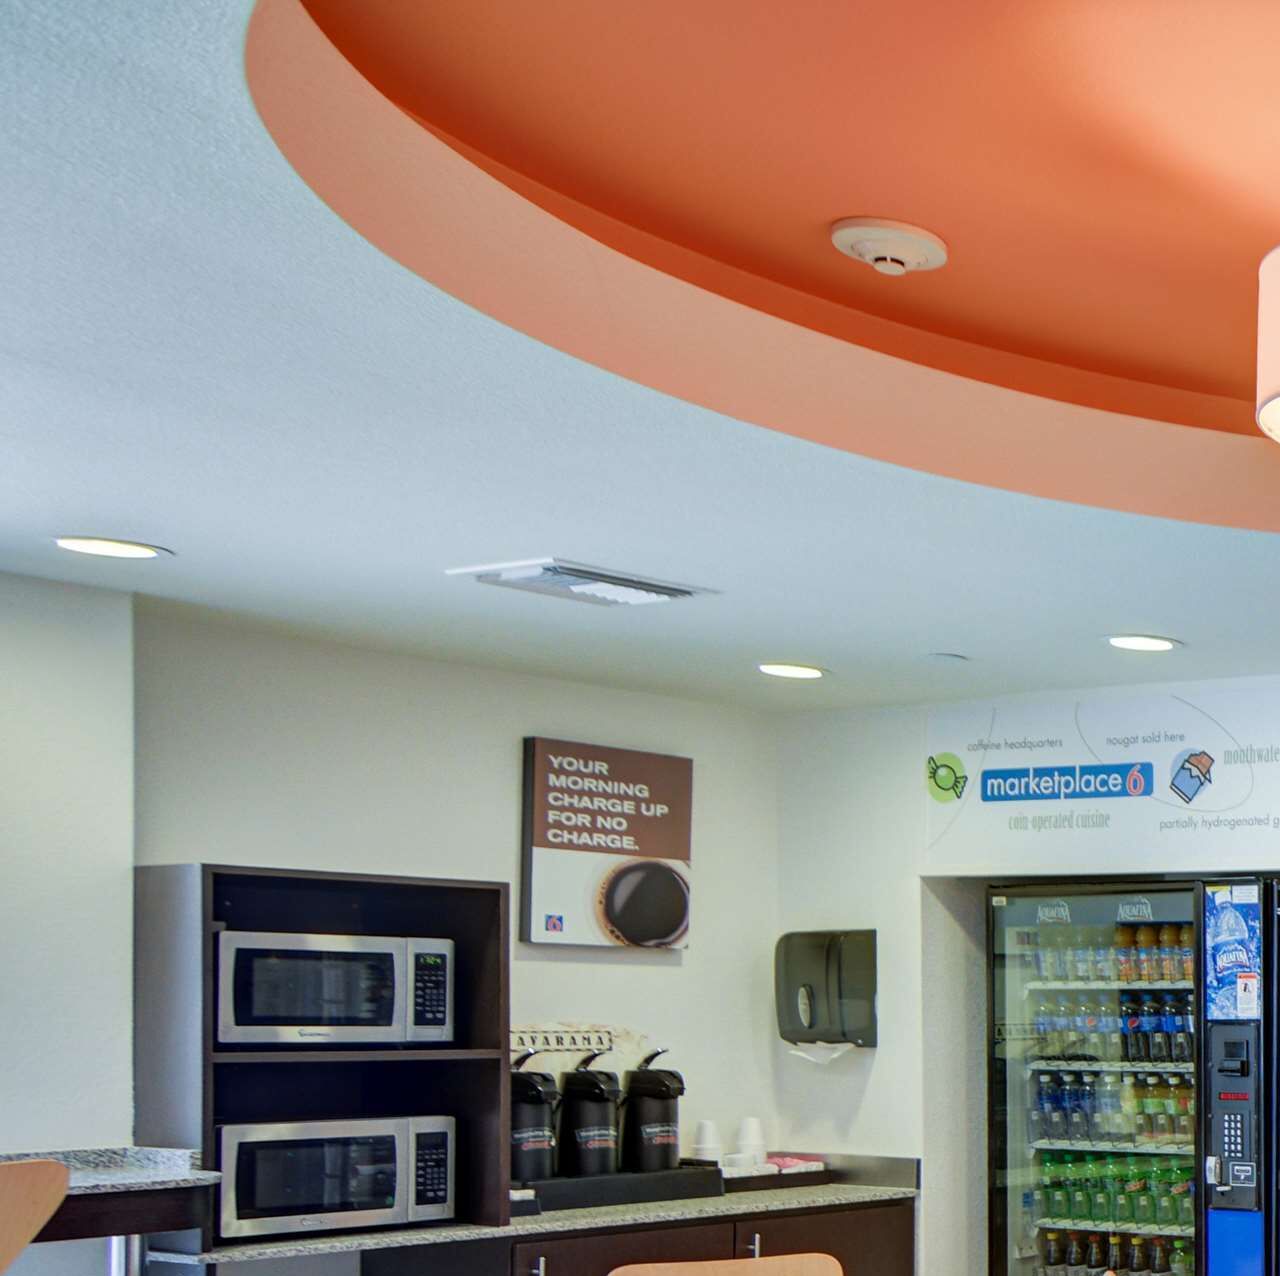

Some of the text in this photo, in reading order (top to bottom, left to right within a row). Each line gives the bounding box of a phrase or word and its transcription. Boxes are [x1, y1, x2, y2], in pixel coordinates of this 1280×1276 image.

[1003, 738, 1063, 750] headquarters
[1106, 732, 1185, 747] nougat sold here
[549, 755, 608, 775] YOUR
[548, 773, 649, 798] MORNING
[987, 763, 1144, 799] marketplace 6
[547, 792, 669, 817] CHARGE UP
[547, 810, 628, 831] FOR NO
[1076, 811, 1110, 828] cuisine
[1160, 816, 1197, 830] partially
[1201, 812, 1270, 830] hydrogenated
[547, 828, 640, 850] CHARGE.
[516, 1035, 605, 1046] AVARAMA
